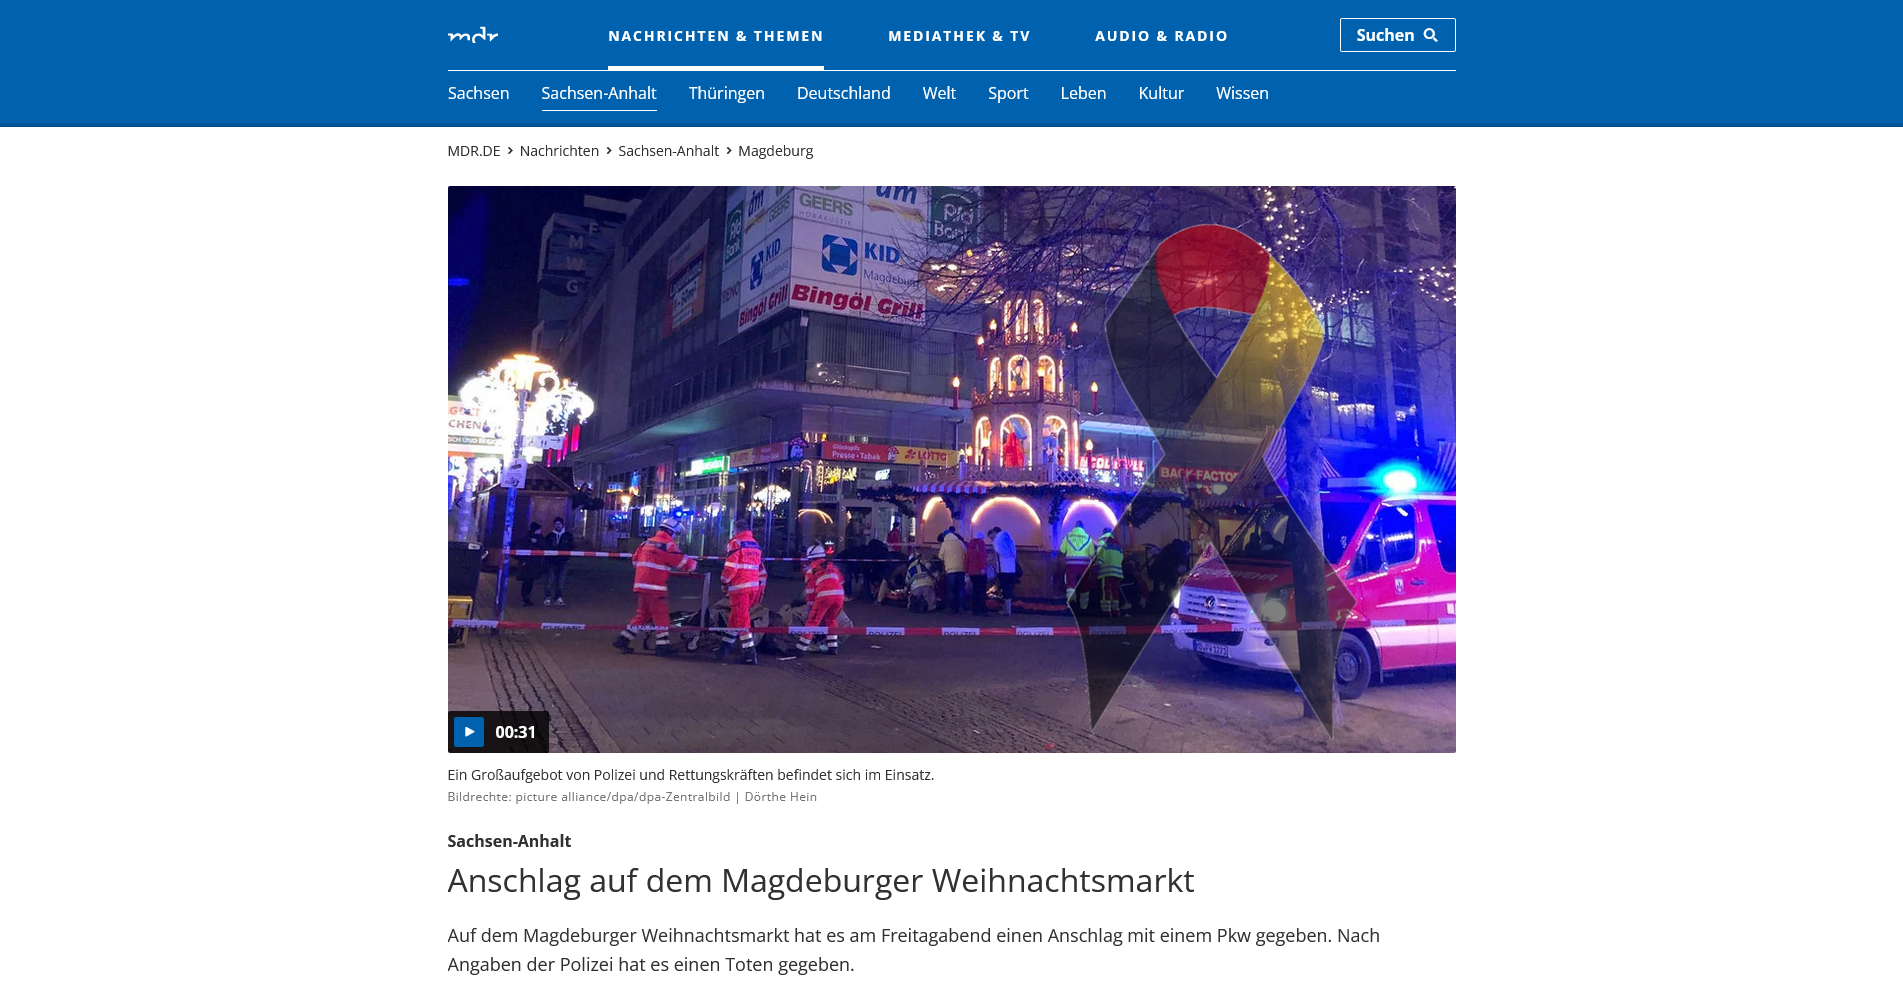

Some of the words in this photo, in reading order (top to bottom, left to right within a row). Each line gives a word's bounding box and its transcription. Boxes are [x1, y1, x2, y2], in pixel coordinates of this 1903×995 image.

[608, 30, 729, 42] NACHRICHTEN
[735, 30, 748, 42] &
[753, 30, 823, 42] THEMEN
[888, 30, 986, 42] MEDIATHEK
[991, 30, 1004, 42] &
[1009, 30, 1031, 42] TV
[1094, 30, 1150, 42] AUDIO
[1156, 30, 1168, 42] &
[1174, 30, 1228, 42] RADIO
[1356, 27, 1415, 42] Suchen
[447, 85, 510, 100] Sachsen
[541, 85, 658, 100] Sachsen-Anhalt
[688, 85, 765, 104] Thüringen
[797, 85, 891, 100] Deutschland
[922, 85, 957, 100] Welt
[988, 86, 1030, 104] Sport
[1061, 85, 1107, 100] Leben
[1139, 85, 1185, 100] Kultur
[1215, 85, 1269, 100] Wissen
[447, 145, 501, 157] MDR.DE
[520, 144, 600, 157] Nachrichten
[618, 144, 720, 157] Sachsen-Anhalt
[738, 144, 814, 160] Magdeburg
[799, 193, 853, 217] GEERS
[764, 238, 781, 263] KID
[864, 241, 901, 264] KID
[768, 282, 789, 311] Grill
[791, 283, 872, 312] Bingöl
[877, 297, 925, 320] Grill
[832, 443, 861, 452] Glückspilz
[832, 450, 856, 460] Presse
[859, 452, 882, 461] Tabak
[917, 450, 947, 462] LOTTO
[447, 768, 468, 781] Ein
[470, 768, 564, 784] Großaufgebot
[565, 771, 591, 781] von
[594, 768, 636, 781] Polizei
[639, 768, 665, 781] und
[669, 768, 774, 784] Rettungskräften
[777, 768, 833, 781] befindet
[835, 768, 861, 781] sich
[864, 768, 881, 781] im
[885, 768, 935, 781] Einsatz.
[447, 791, 512, 802] Bildrechte:
[515, 792, 558, 805] picture
[560, 791, 731, 805] alliance/dpa/dpa-Zentralbild
[744, 791, 787, 802] Dörthe
[790, 791, 818, 802] Hein
[447, 833, 572, 848] Sachsen-Anhalt
[447, 867, 582, 901] Anschlag
[589, 867, 640, 893] auf
[646, 867, 712, 893] dem
[723, 867, 924, 901] Magdeburger
[931, 867, 1195, 893] Weihnachtsmarkt
[447, 927, 478, 943] Auf
[480, 927, 518, 943] dem
[523, 927, 638, 947] Magdeburger
[640, 927, 790, 943] Weihnachtsmarkt
[794, 927, 822, 943] hat
[826, 931, 845, 943] es
[849, 931, 876, 943] am
[881, 927, 991, 947] Freitagabend
[996, 927, 1043, 943] einen
[1047, 927, 1124, 947] Anschlag
[1127, 927, 1156, 943] mit
[1159, 927, 1212, 943] einem
[1217, 927, 1252, 943] Pkw
[1255, 927, 1332, 947] gegeben.
[1337, 927, 1380, 943] Nach
[447, 956, 522, 976] Angaben
[526, 956, 556, 972] der
[560, 956, 614, 972] Polizei
[618, 956, 647, 972] hat
[650, 960, 670, 972] es
[673, 956, 720, 972] einen
[724, 957, 773, 972] Toten
[777, 956, 855, 976] gegeben.
